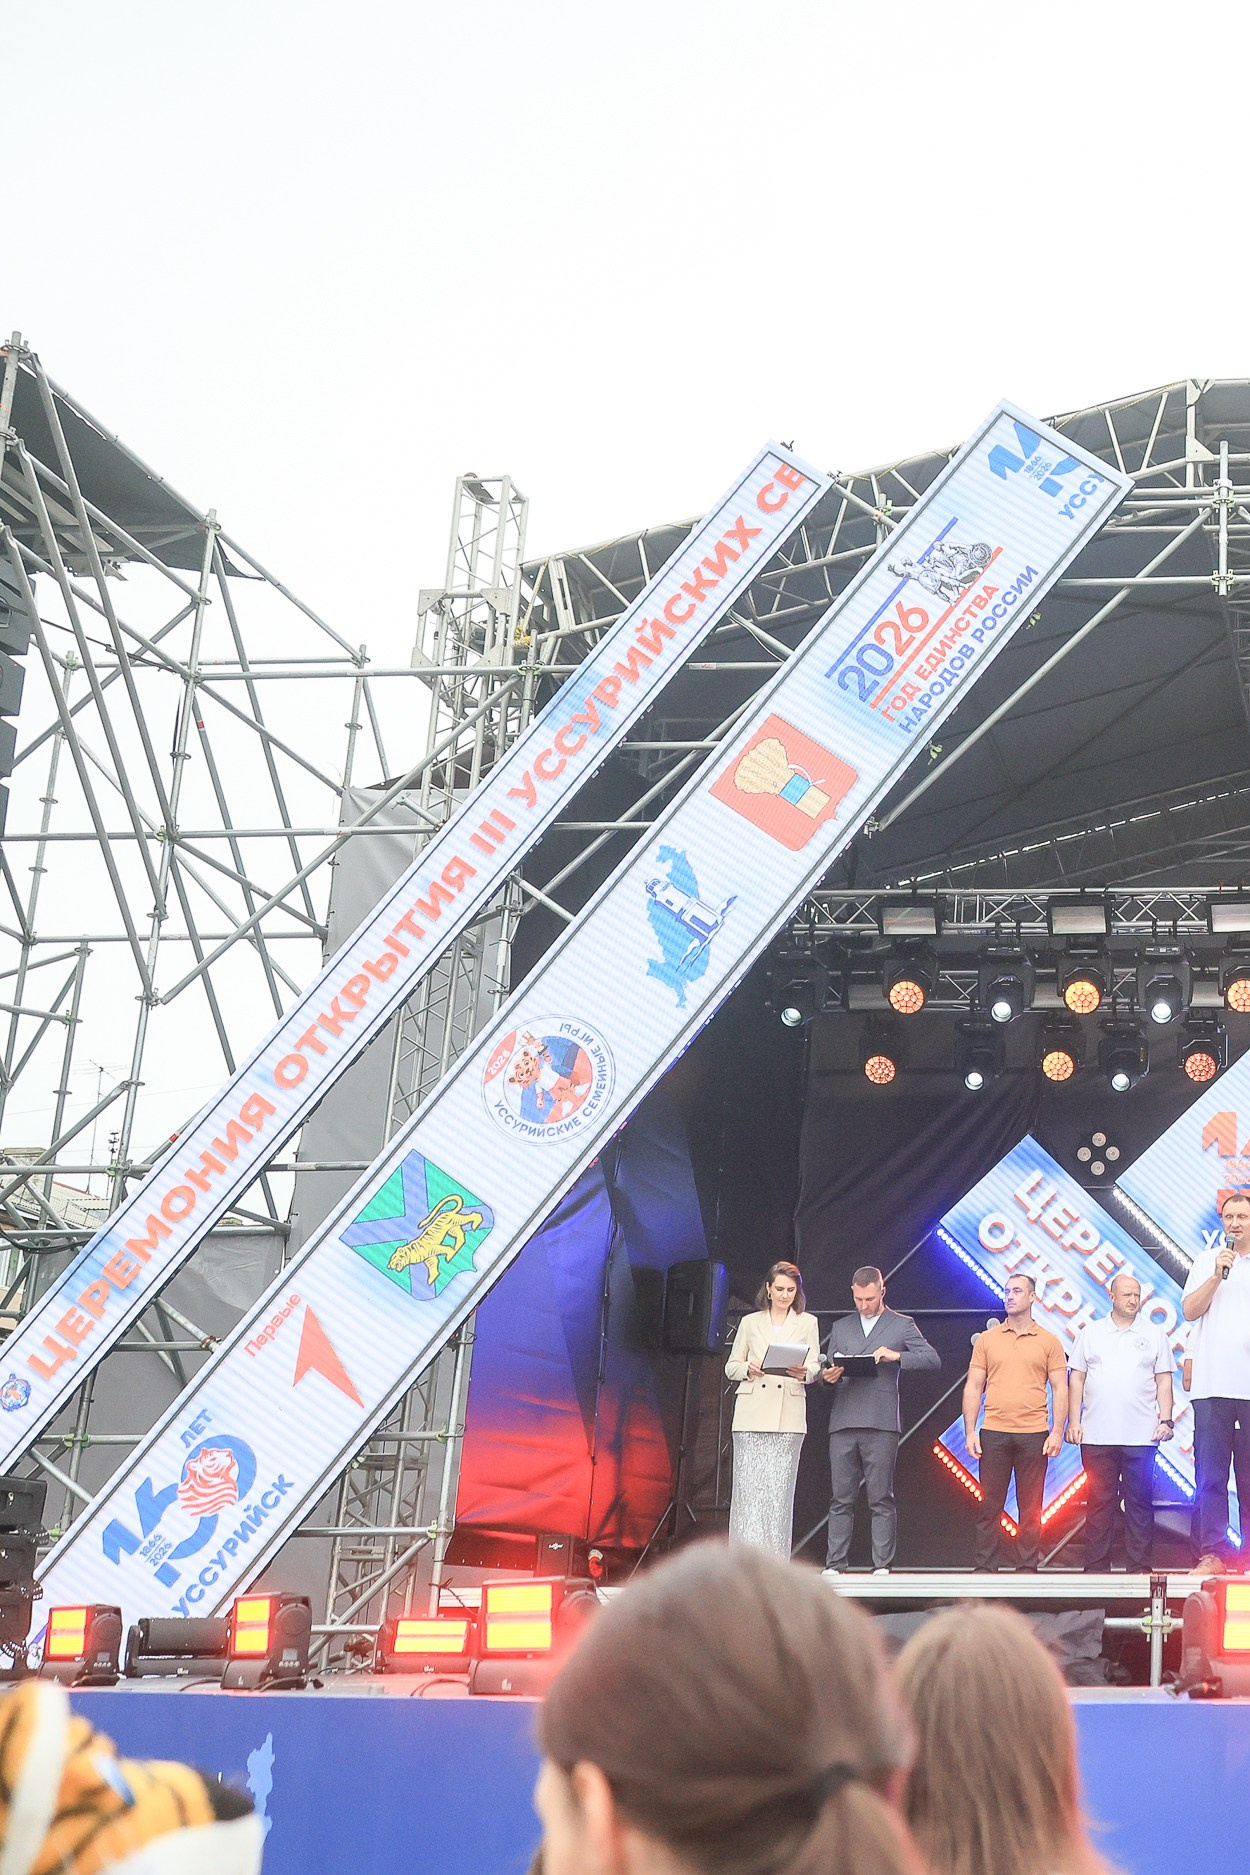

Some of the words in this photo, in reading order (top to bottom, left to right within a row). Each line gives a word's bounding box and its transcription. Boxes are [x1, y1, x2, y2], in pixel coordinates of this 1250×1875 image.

[1034, 462, 1053, 481] 2026
[837, 601, 929, 702] 2026
[881, 681, 922, 723] ГОД
[915, 585, 1000, 681] ЕДИНСТВА
[898, 644, 975, 734] НАРОДОВ
[971, 565, 1039, 643] РОССИИ
[28, 1092, 277, 1380] ЦЕРЕМОНИЯ
[272, 856, 477, 1090] ОТКРЫТИЯ
[471, 809, 516, 854] III
[507, 516, 763, 808] УССУРИЙСКИХ
[757, 463, 806, 513] СЕ
[560, 1022, 594, 1046] ИГРЫ
[488, 1049, 511, 1076] 2026
[243, 1293, 302, 1358] Первые
[179, 1408, 213, 1449] ЛЕТ
[139, 1533, 163, 1557] 1866
[149, 1541, 174, 1567] 2026
[171, 1473, 295, 1618] УССУРИЙСК
